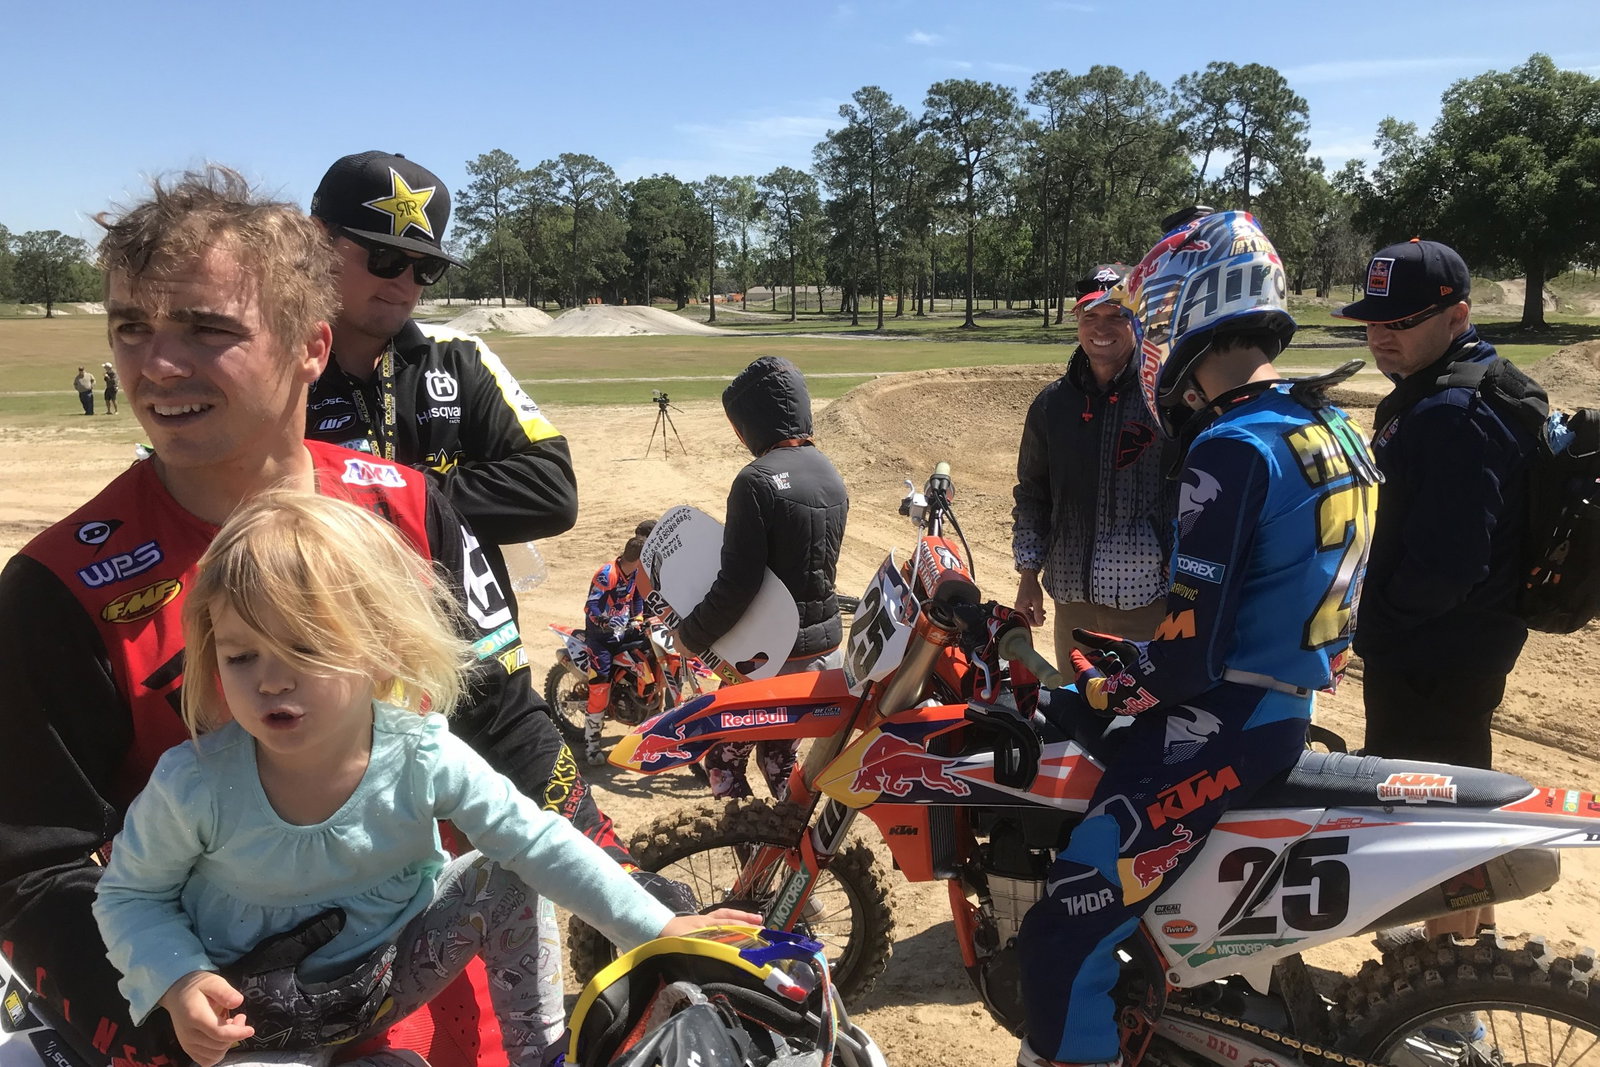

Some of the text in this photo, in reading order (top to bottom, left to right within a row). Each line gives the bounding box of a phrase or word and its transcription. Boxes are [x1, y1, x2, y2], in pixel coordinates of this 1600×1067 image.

[79, 541, 161, 587] WPS
[106, 578, 178, 622] FMF
[721, 706, 789, 729] Red Bull
[1146, 765, 1242, 830] KTM
[1380, 785, 1401, 798] SELLE
[1388, 773, 1449, 786] KTM
[773, 870, 810, 927] MOTOREX
[1060, 887, 1115, 917] THOR
[1217, 836, 1351, 937] 25
